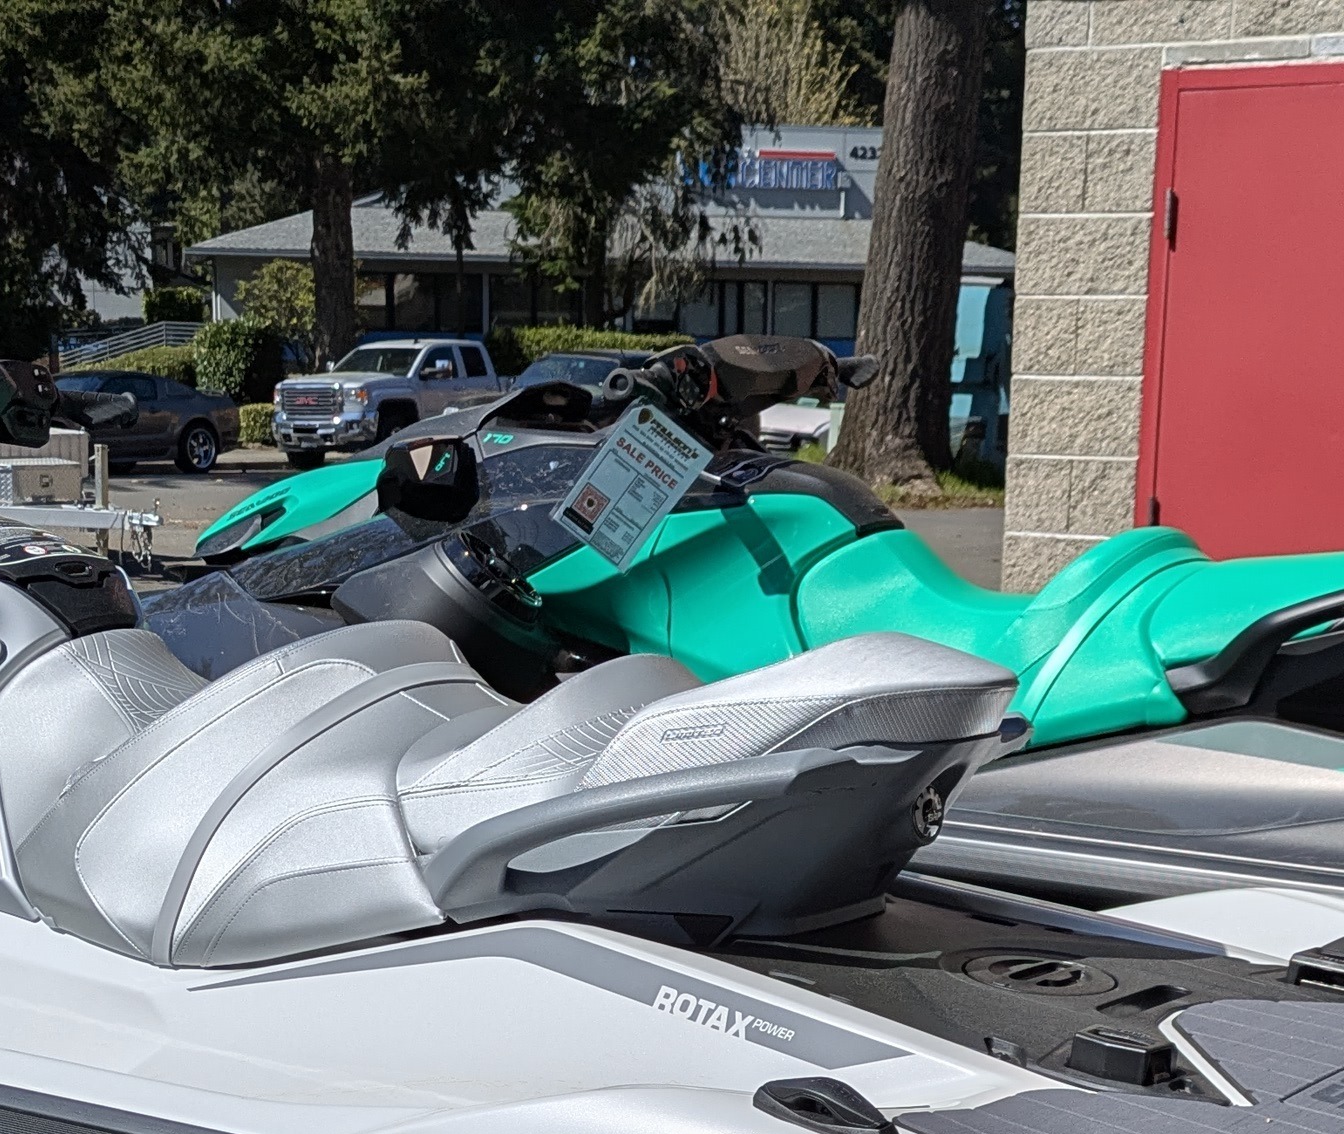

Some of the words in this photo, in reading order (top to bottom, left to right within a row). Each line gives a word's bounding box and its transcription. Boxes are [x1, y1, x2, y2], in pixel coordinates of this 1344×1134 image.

[850, 146, 880, 160] 423
[740, 159, 838, 189] CENTER
[483, 433, 514, 444] 170
[615, 436, 646, 464] SALE
[644, 459, 679, 490] PRICE
[653, 984, 754, 1041] ROTAX
[752, 1018, 796, 1042] POWER
